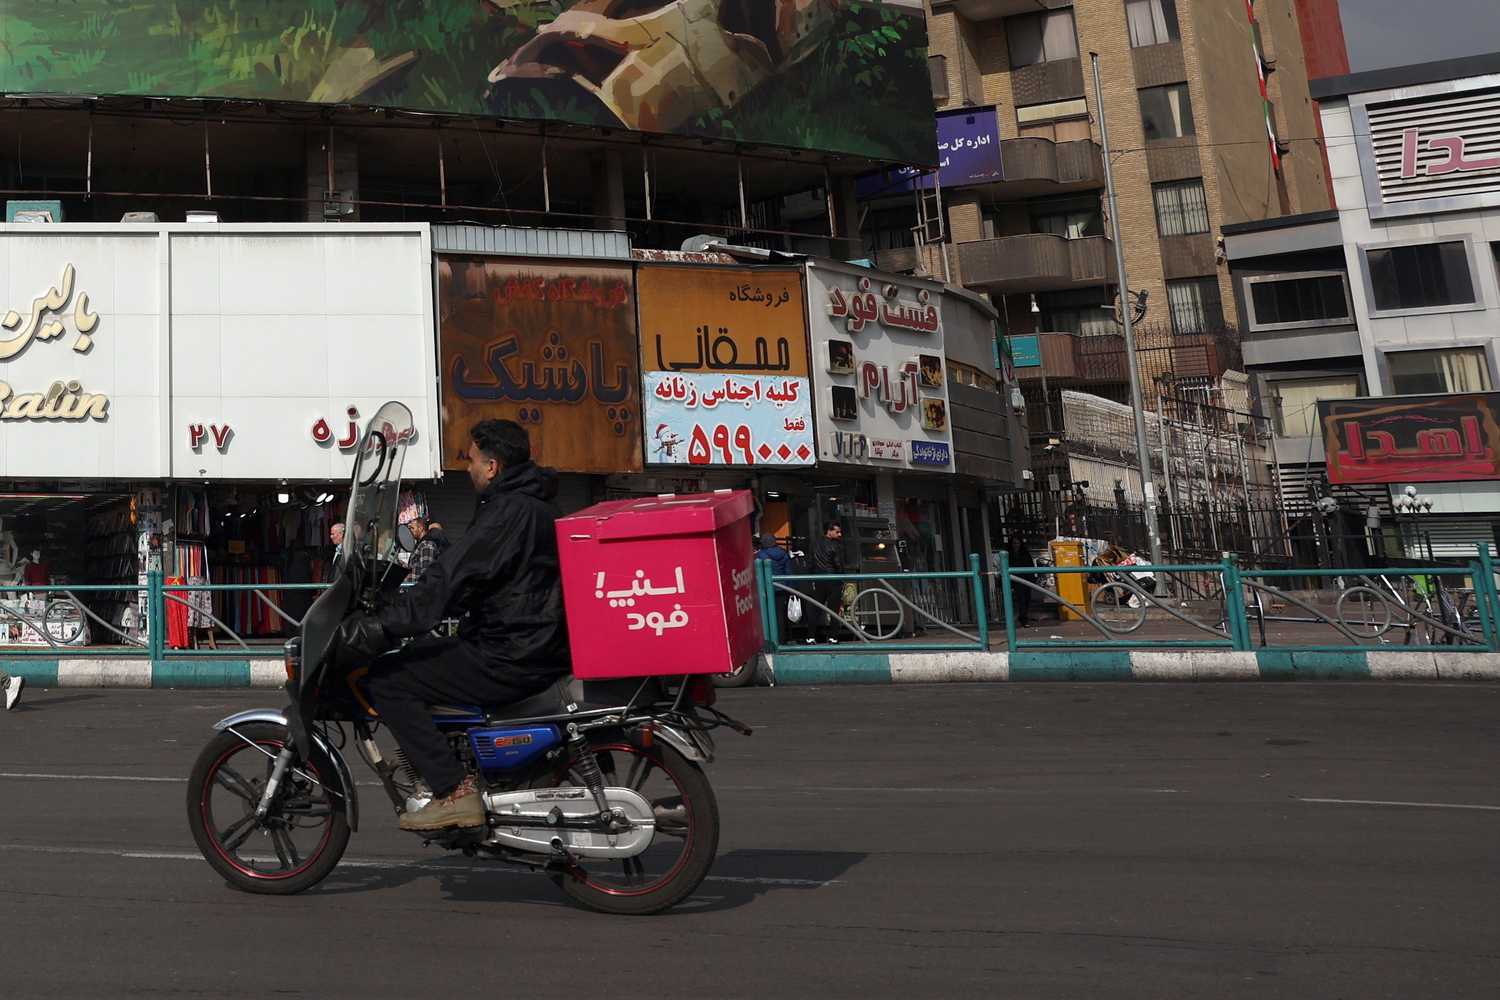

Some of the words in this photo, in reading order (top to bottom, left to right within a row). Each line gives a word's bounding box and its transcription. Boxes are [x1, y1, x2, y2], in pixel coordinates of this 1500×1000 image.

[950, 137, 965, 151] کل
[967, 134, 990, 149] اداره
[493, 277, 545, 305] کفش
[549, 277, 628, 308] فروشگاه
[729, 284, 790, 308] فروشگاه
[828, 278, 878, 332] فود
[880, 284, 940, 333] فست
[655, 376, 697, 406] زنانه
[702, 379, 761, 407] اجناس
[765, 381, 799, 407] کلیه
[859, 361, 919, 412] آرام
[189, 422, 231, 449] ۲۷
[783, 417, 806, 431] فقط
[1344, 416, 1484, 459] اهدا
[688, 424, 811, 465] ۵۹۹۰۰۰
[626, 603, 689, 636] فود
